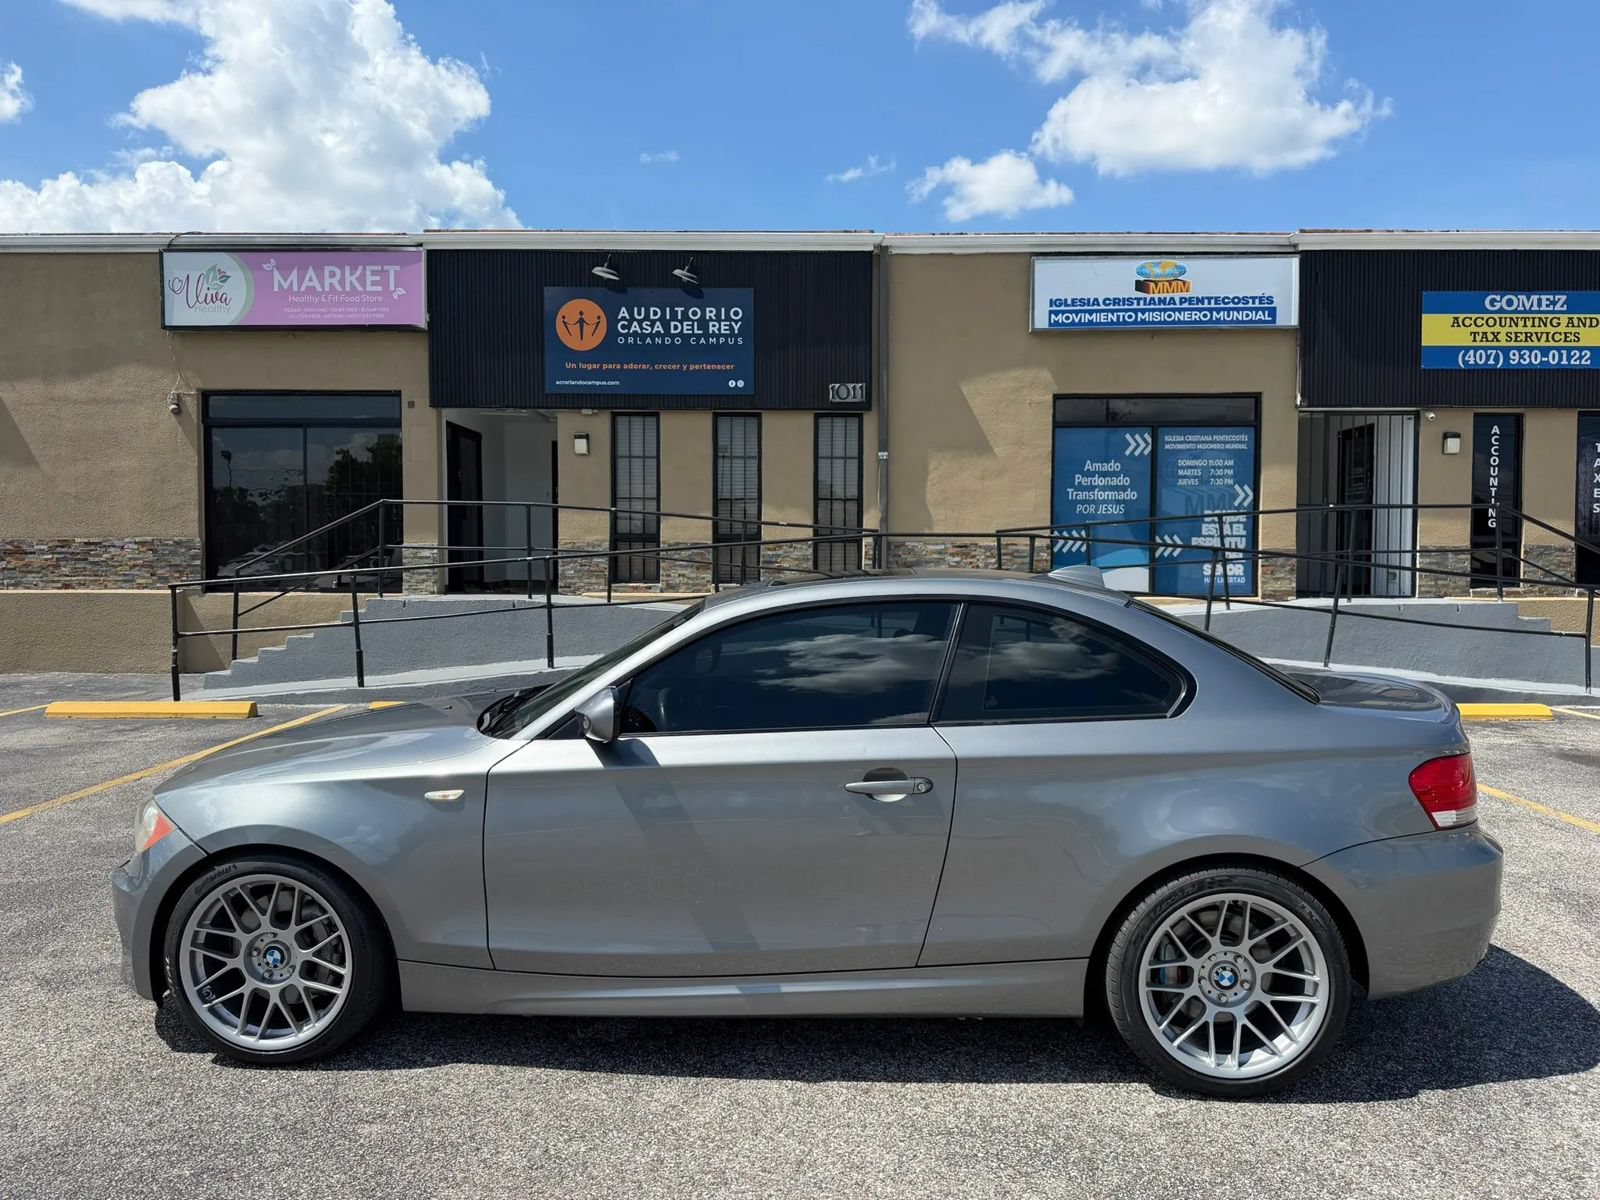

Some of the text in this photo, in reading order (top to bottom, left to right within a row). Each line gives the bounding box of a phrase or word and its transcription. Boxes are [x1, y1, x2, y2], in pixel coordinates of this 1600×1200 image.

[273, 265, 400, 292] MARKET
[1149, 280, 1191, 295] MMM
[288, 294, 319, 304] Healthy
[328, 294, 338, 302] Fit
[341, 294, 360, 302] Food
[361, 294, 383, 302] Store
[1049, 293, 1274, 308] IGLESIA CRISTIANA PENTECOSTÉS
[1484, 295, 1568, 311] GOMEZ
[617, 306, 743, 320] AUDITORIO
[1051, 310, 1272, 324] MOVIMIENTO MISIONERO MUNDIAL
[617, 321, 743, 334] CASA DEL REY
[1450, 317, 1600, 328] ACCOUNTING AND
[617, 337, 743, 345] ORLANDO CAMPUS
[1470, 331, 1581, 343] TAX SERVICES
[1458, 350, 1591, 368] (407) 930-0122
[579, 362, 600, 372] lugar
[602, 363, 621, 371] para
[689, 363, 735, 372] pertenecer
[829, 383, 866, 402] 1011
[1084, 460, 1121, 472] Amado
[1075, 474, 1130, 486] Perdonado
[1177, 478, 1234, 486] JUEVES 7:30 PM
[1487, 425, 1500, 528] ACCOUNTING
[1067, 488, 1138, 500] Transformado
[1076, 504, 1125, 514] POR JESUS
[1232, 523, 1247, 536] EL
